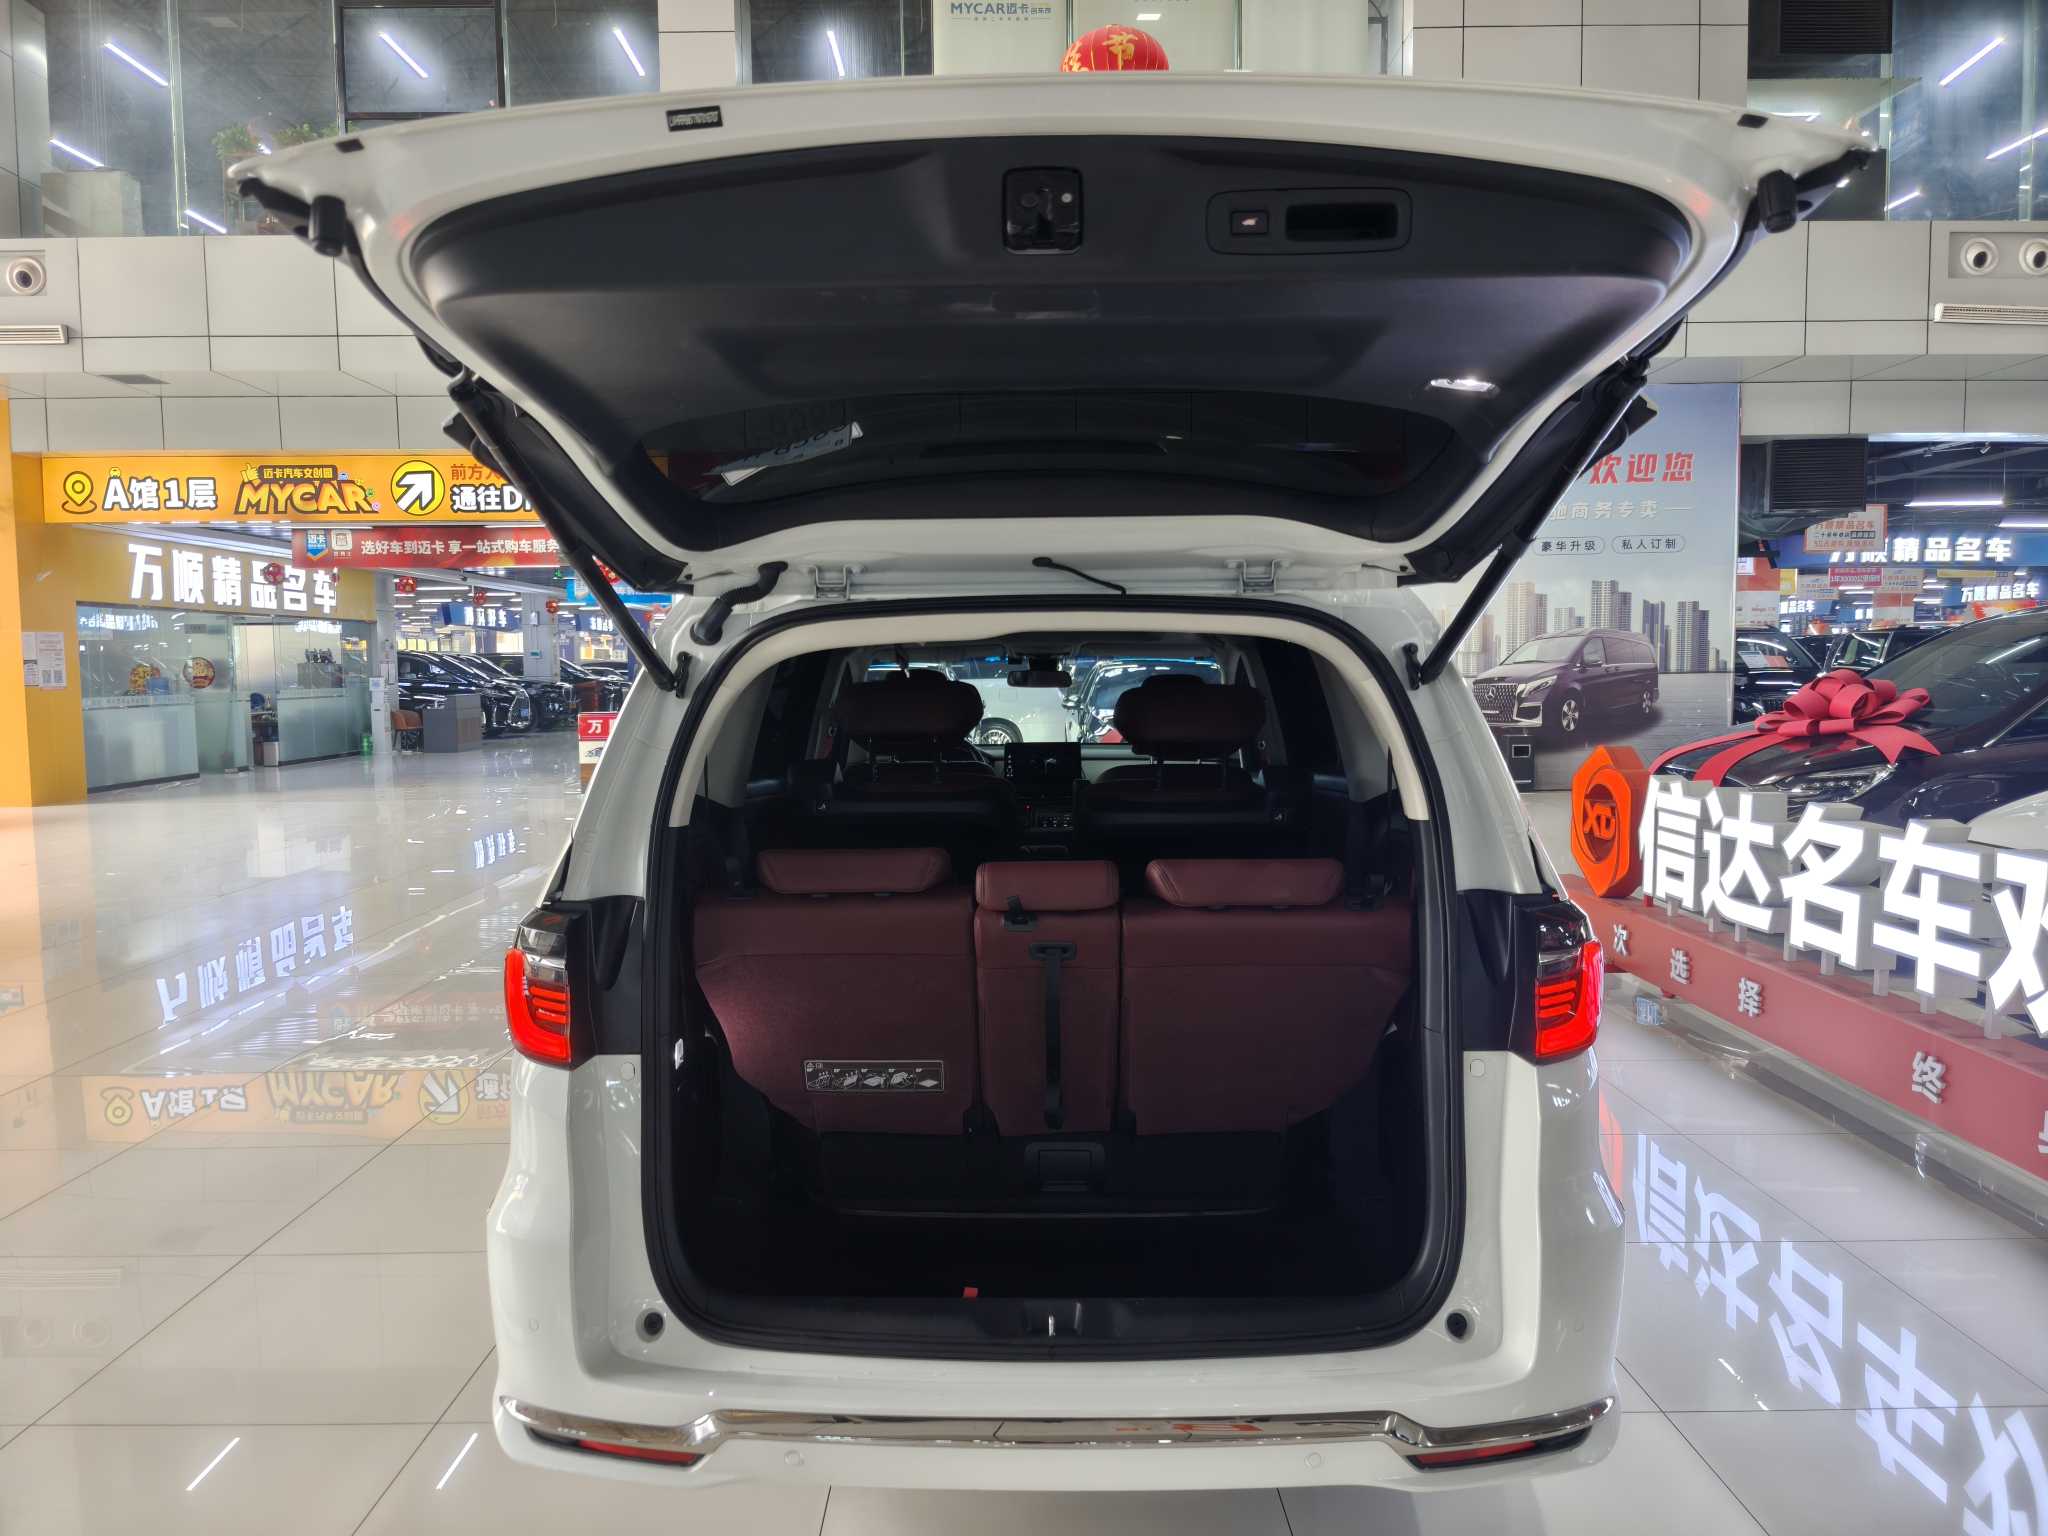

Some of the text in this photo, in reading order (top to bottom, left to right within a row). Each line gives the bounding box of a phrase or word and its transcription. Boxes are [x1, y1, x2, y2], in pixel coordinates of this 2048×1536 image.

[236, 482, 375, 513] MYCAR
[361, 540, 445, 555] 选好车到迈卡
[1541, 537, 1677, 552] 豪华升级 私人订制
[128, 543, 338, 614] 万顺精品名车
